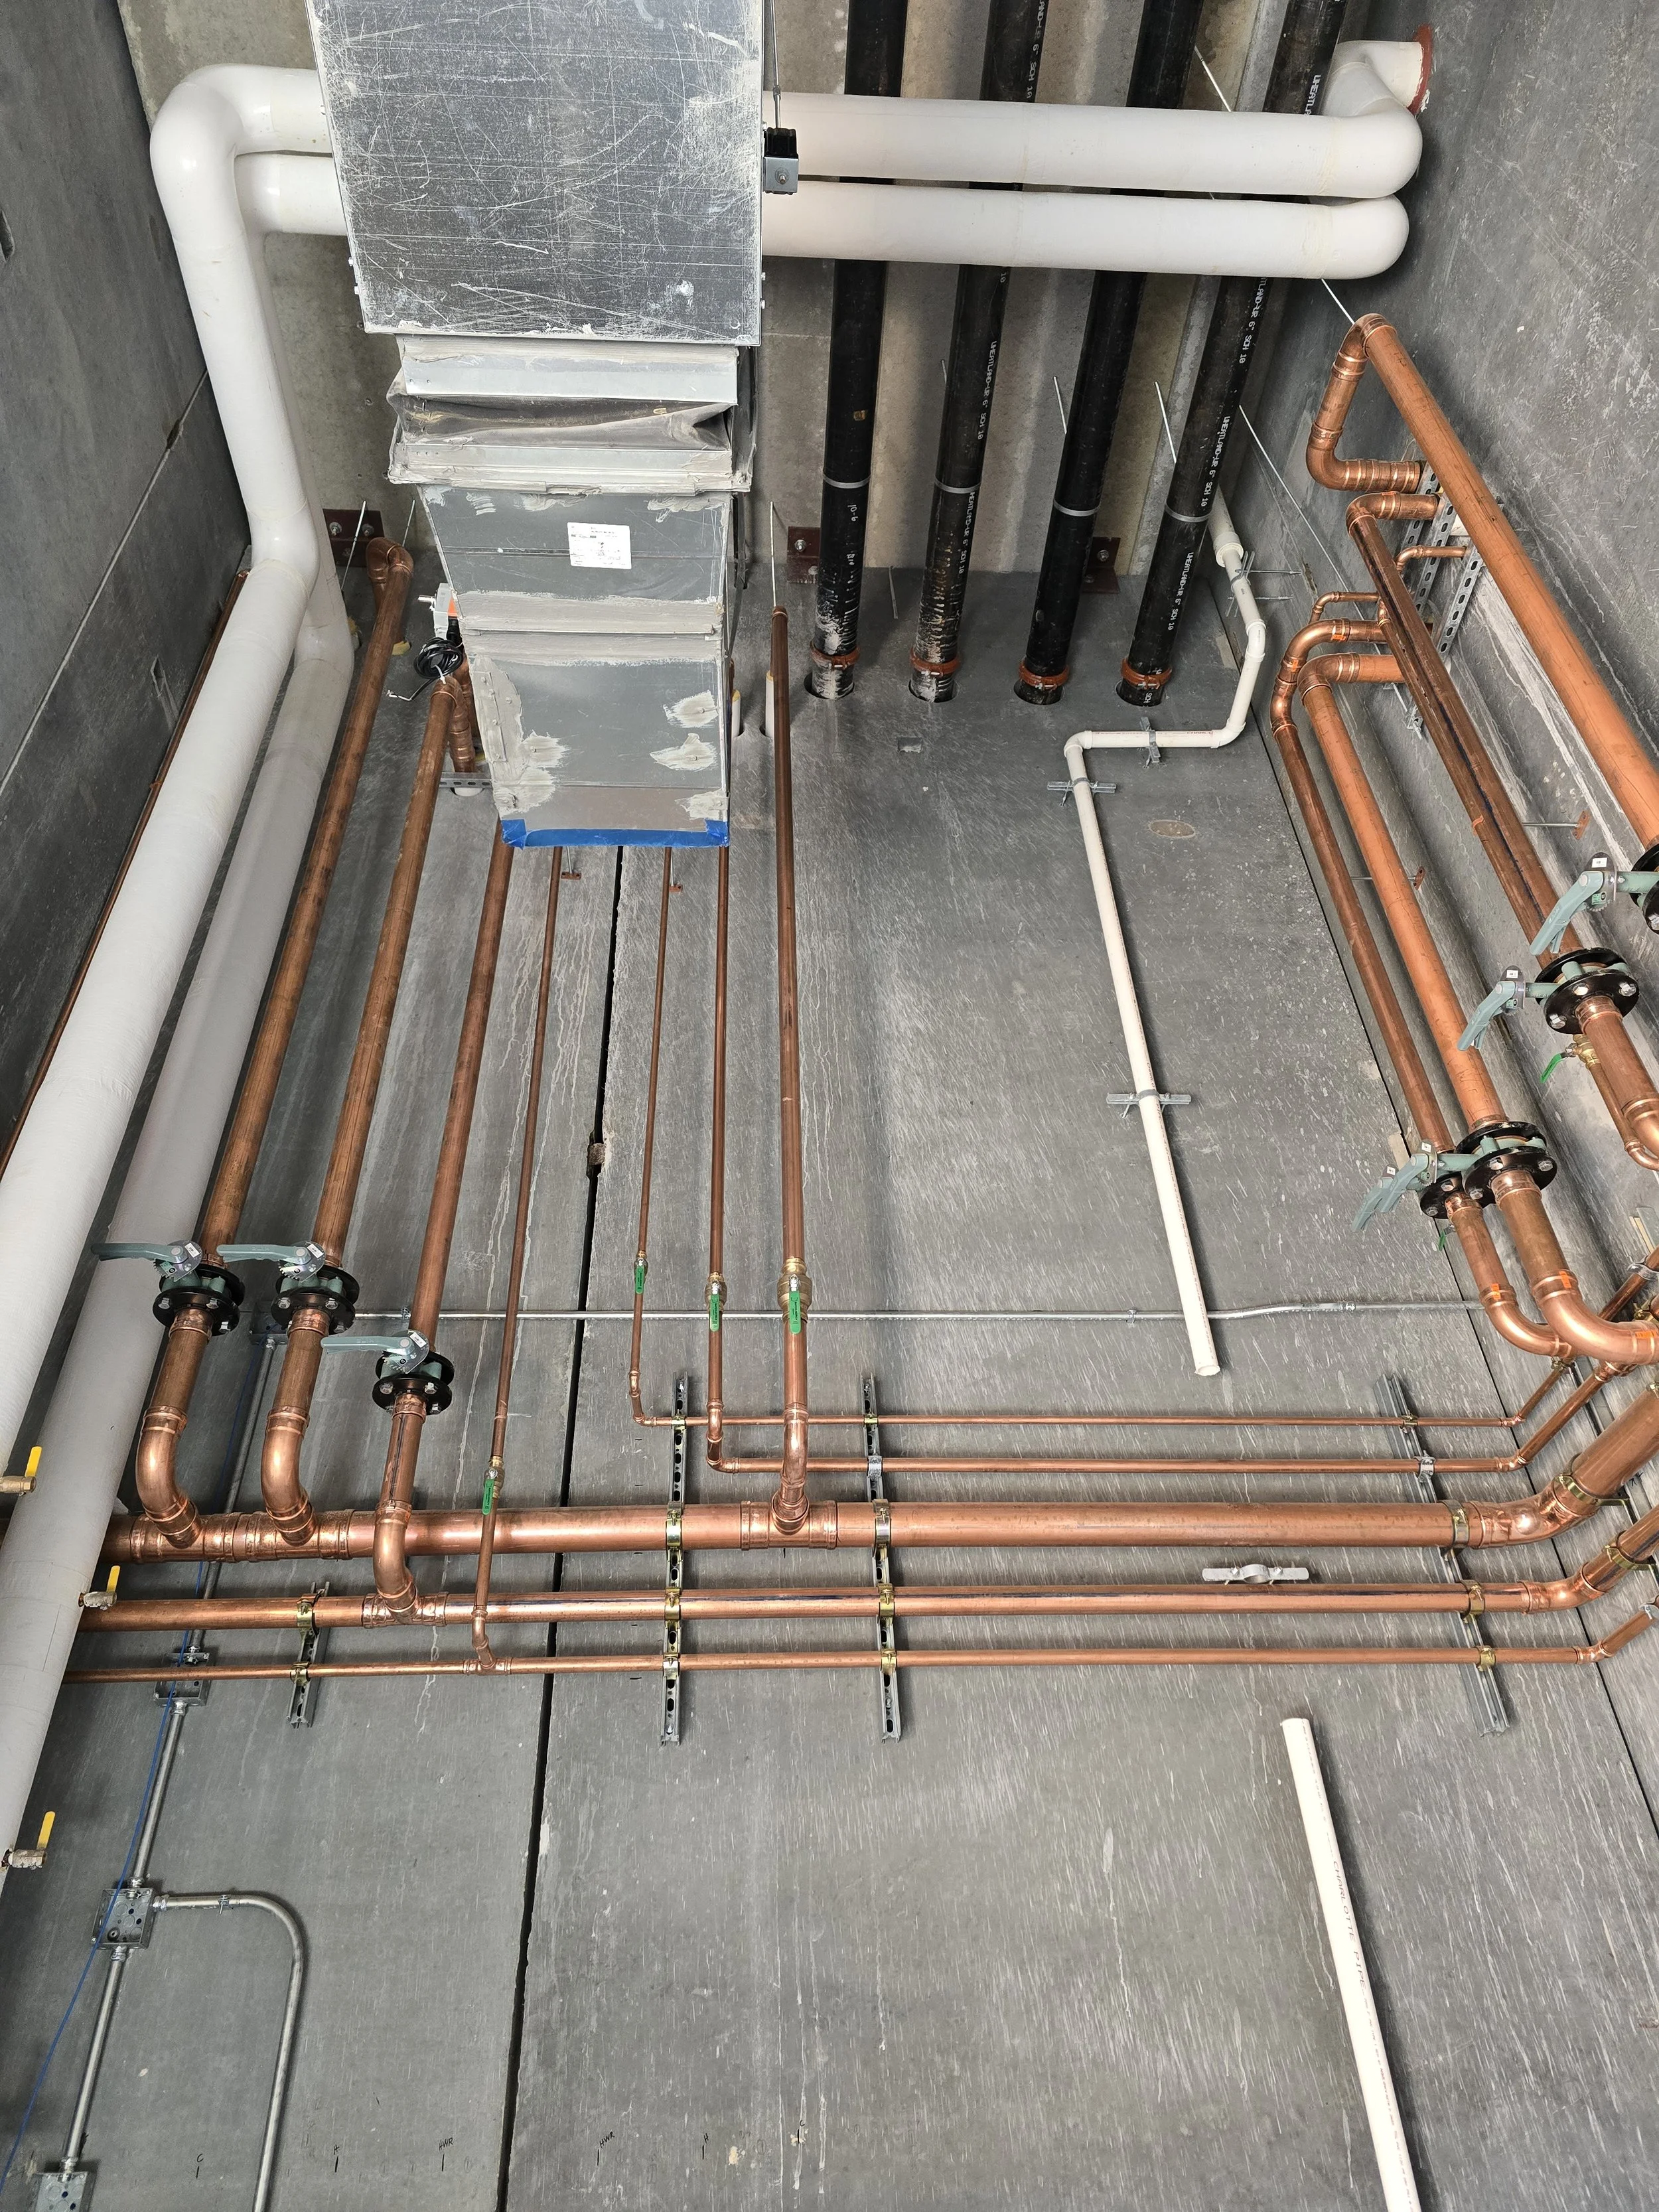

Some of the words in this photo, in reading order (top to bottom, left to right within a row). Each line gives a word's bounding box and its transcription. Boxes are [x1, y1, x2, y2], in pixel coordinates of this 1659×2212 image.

[1028, 61, 1037, 81] SCH
[1242, 334, 1252, 350] SCH
[1239, 354, 1247, 364] 10
[977, 431, 984, 440] 10
[1203, 481, 1213, 495] SCH
[1200, 498, 1208, 507] 10
[958, 565, 965, 574] 10
[1170, 609, 1179, 621] SCH
[1167, 622, 1175, 630] 10
[1143, 692, 1153, 703] SCH
[1333, 1860, 1355, 1942] CHARLOTTE
[1353, 1951, 1366, 1990] PIPE
[439, 2137, 454, 2151] HWR
[599, 2131, 615, 2148] HWR
[703, 2132, 709, 2144] H
[196, 2153, 204, 2163] C
